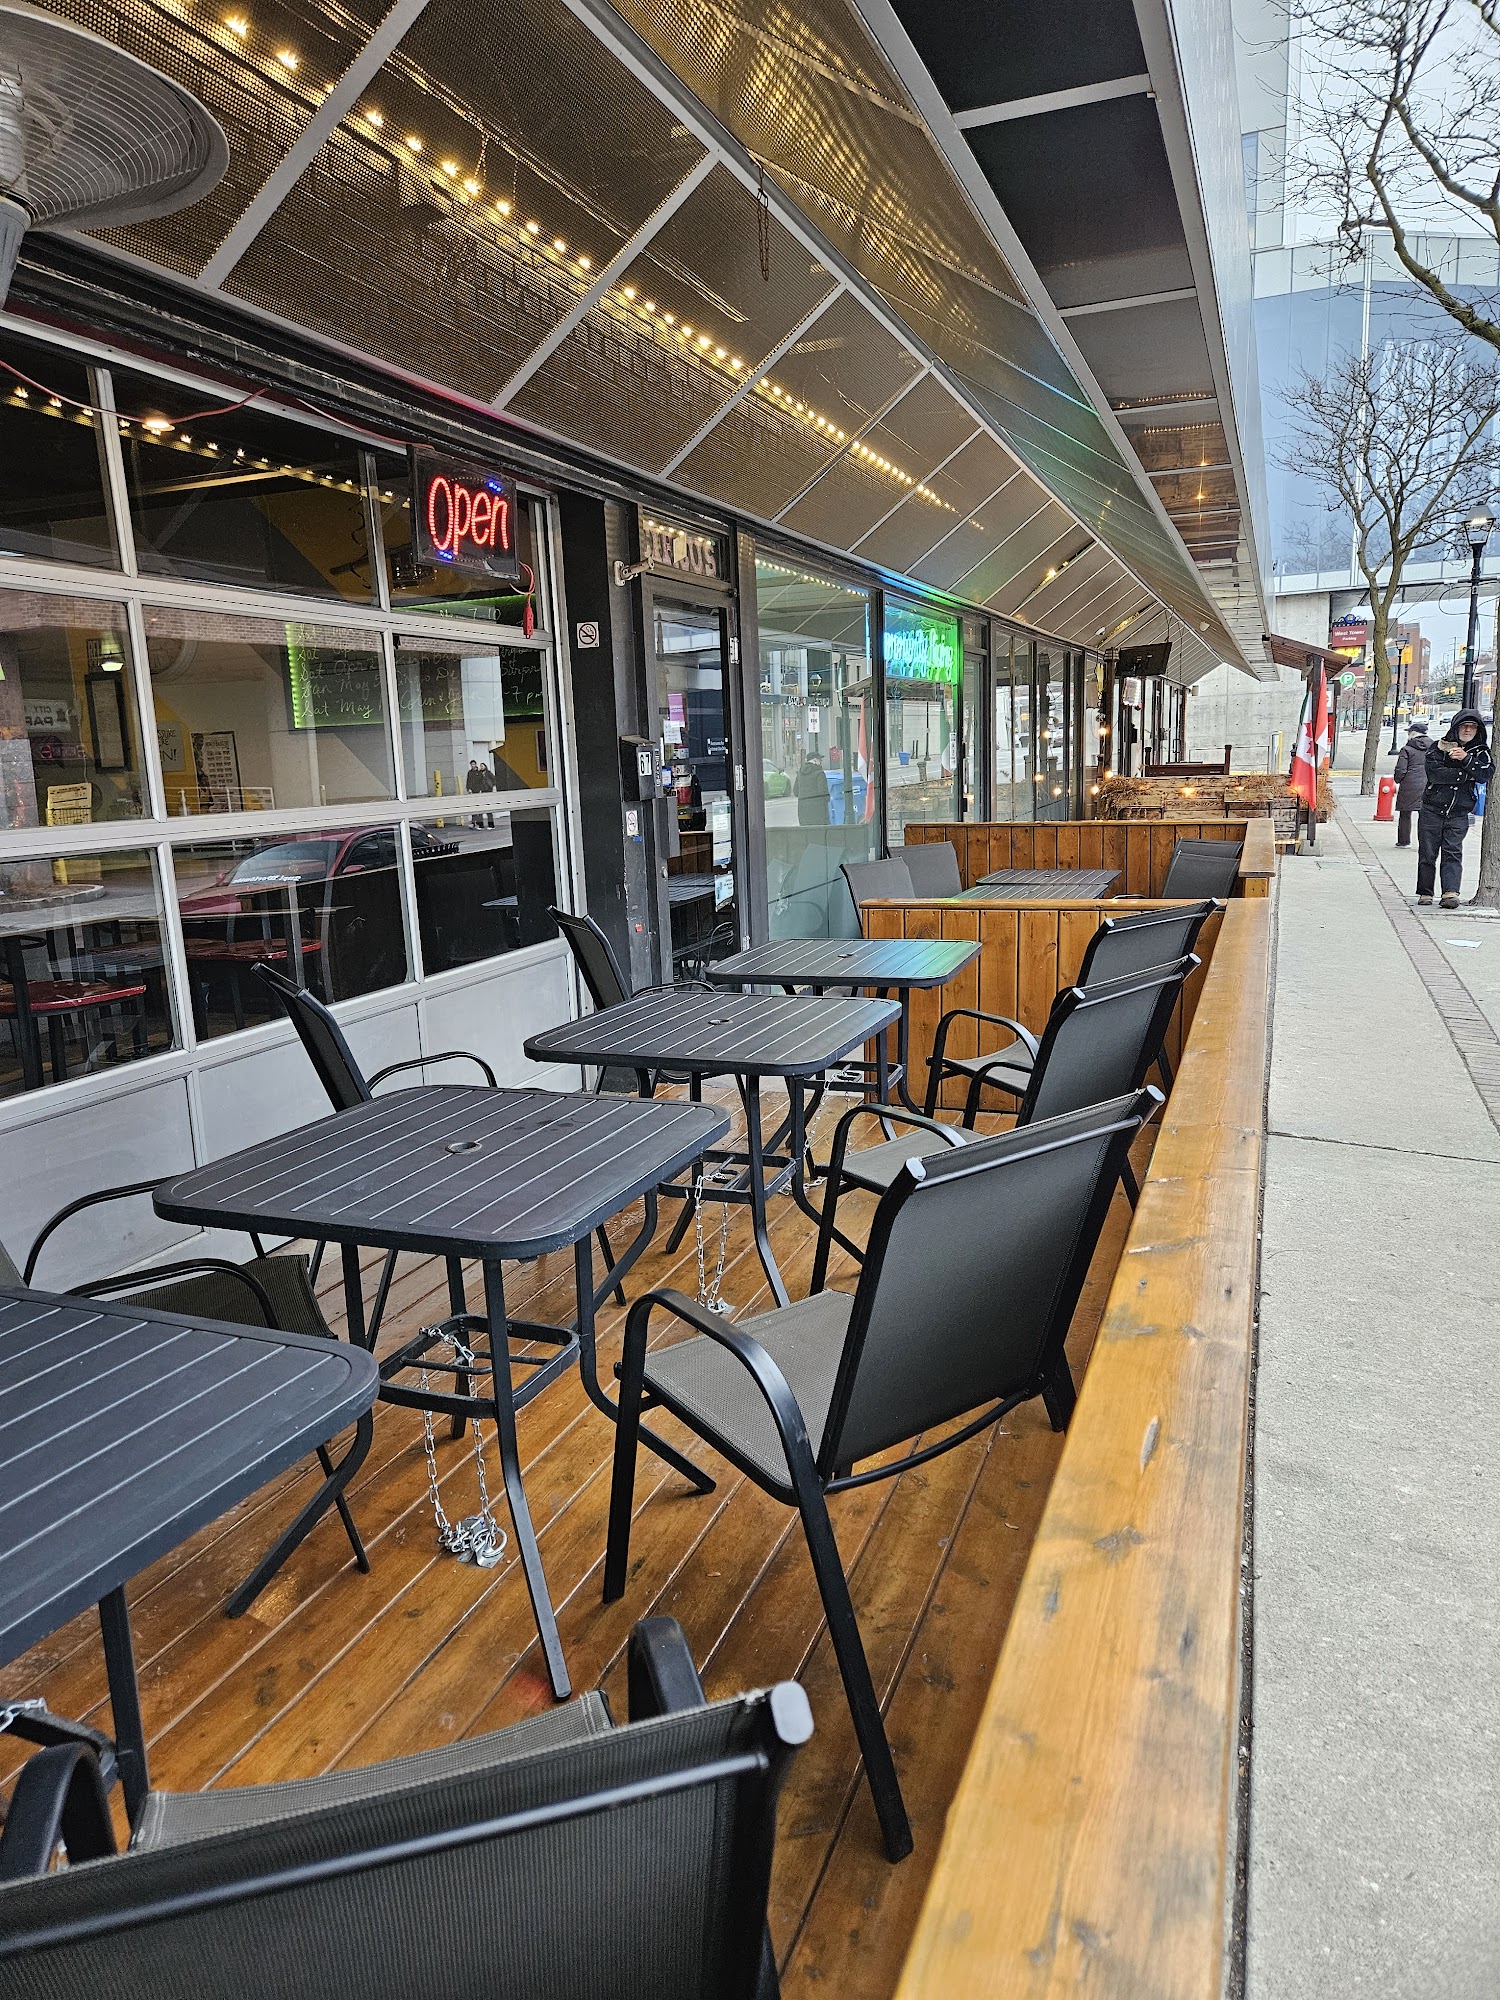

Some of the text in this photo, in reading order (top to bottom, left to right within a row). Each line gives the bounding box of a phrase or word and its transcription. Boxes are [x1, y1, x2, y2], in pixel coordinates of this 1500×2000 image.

[428, 476, 509, 556] Open
[301, 701, 330, 718] Sat
[335, 698, 375, 719] May
[640, 753, 651, 774] 67
